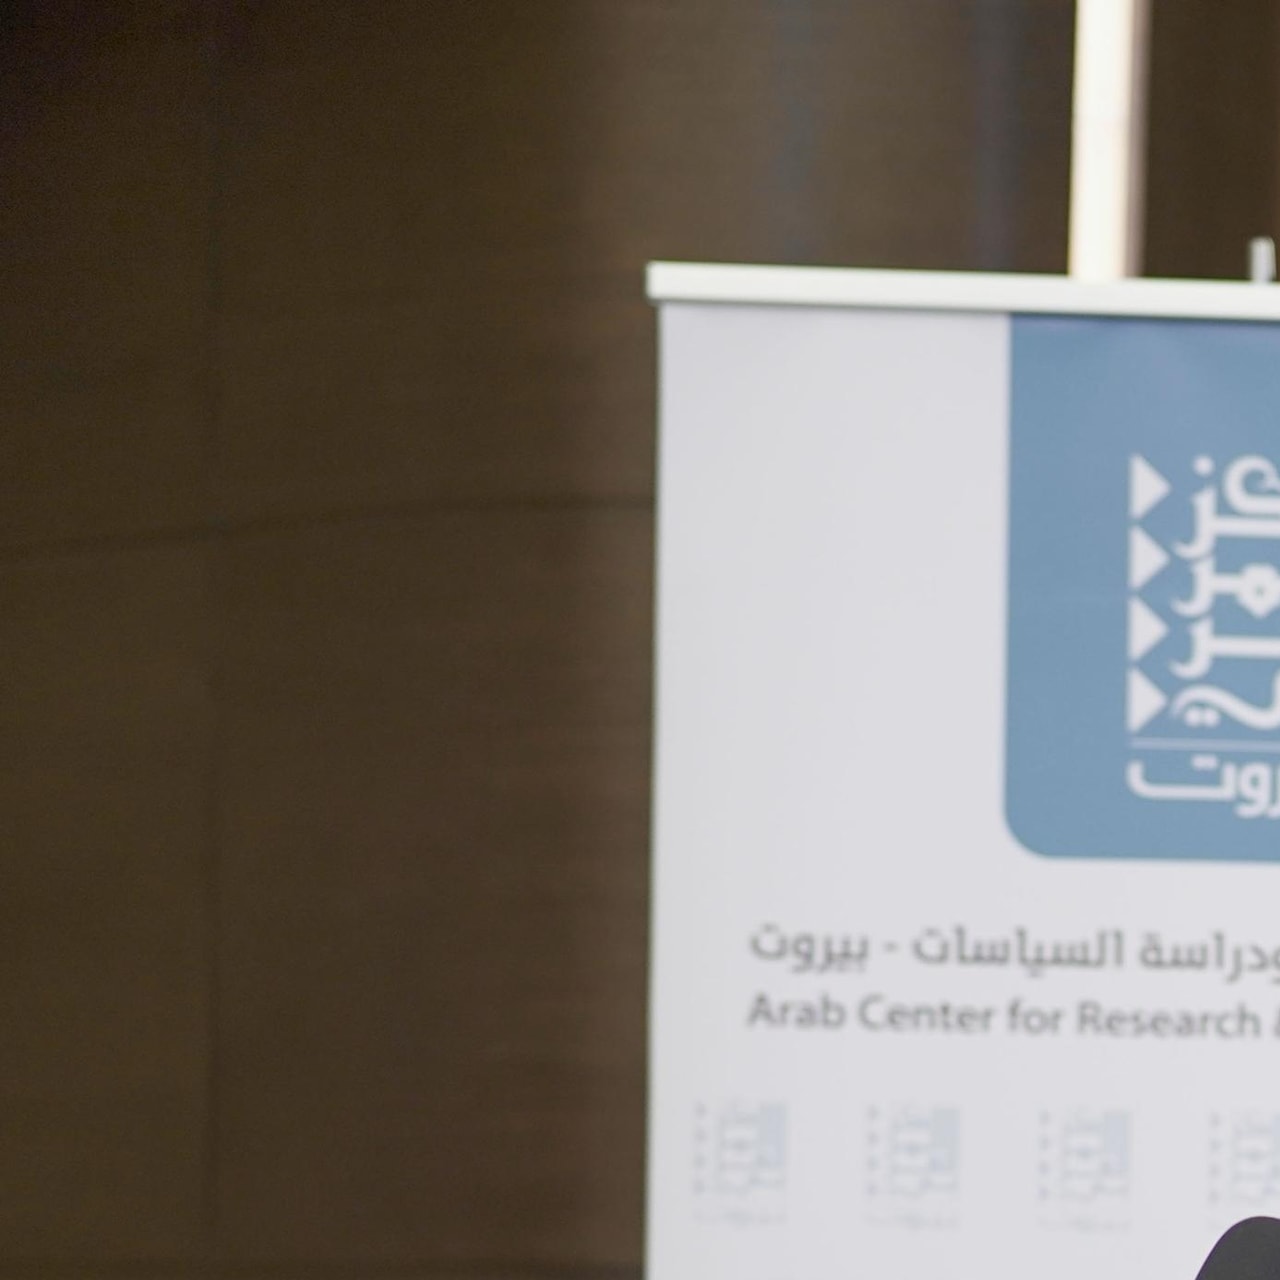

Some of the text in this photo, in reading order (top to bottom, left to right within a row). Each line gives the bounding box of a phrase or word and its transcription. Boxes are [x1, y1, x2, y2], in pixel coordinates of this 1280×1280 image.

[750, 922, 871, 975] بيروت
[746, 993, 847, 1030] Arab
[858, 994, 996, 1033] Center
[1007, 998, 1064, 1035] for
[1078, 1000, 1262, 1040] Research
